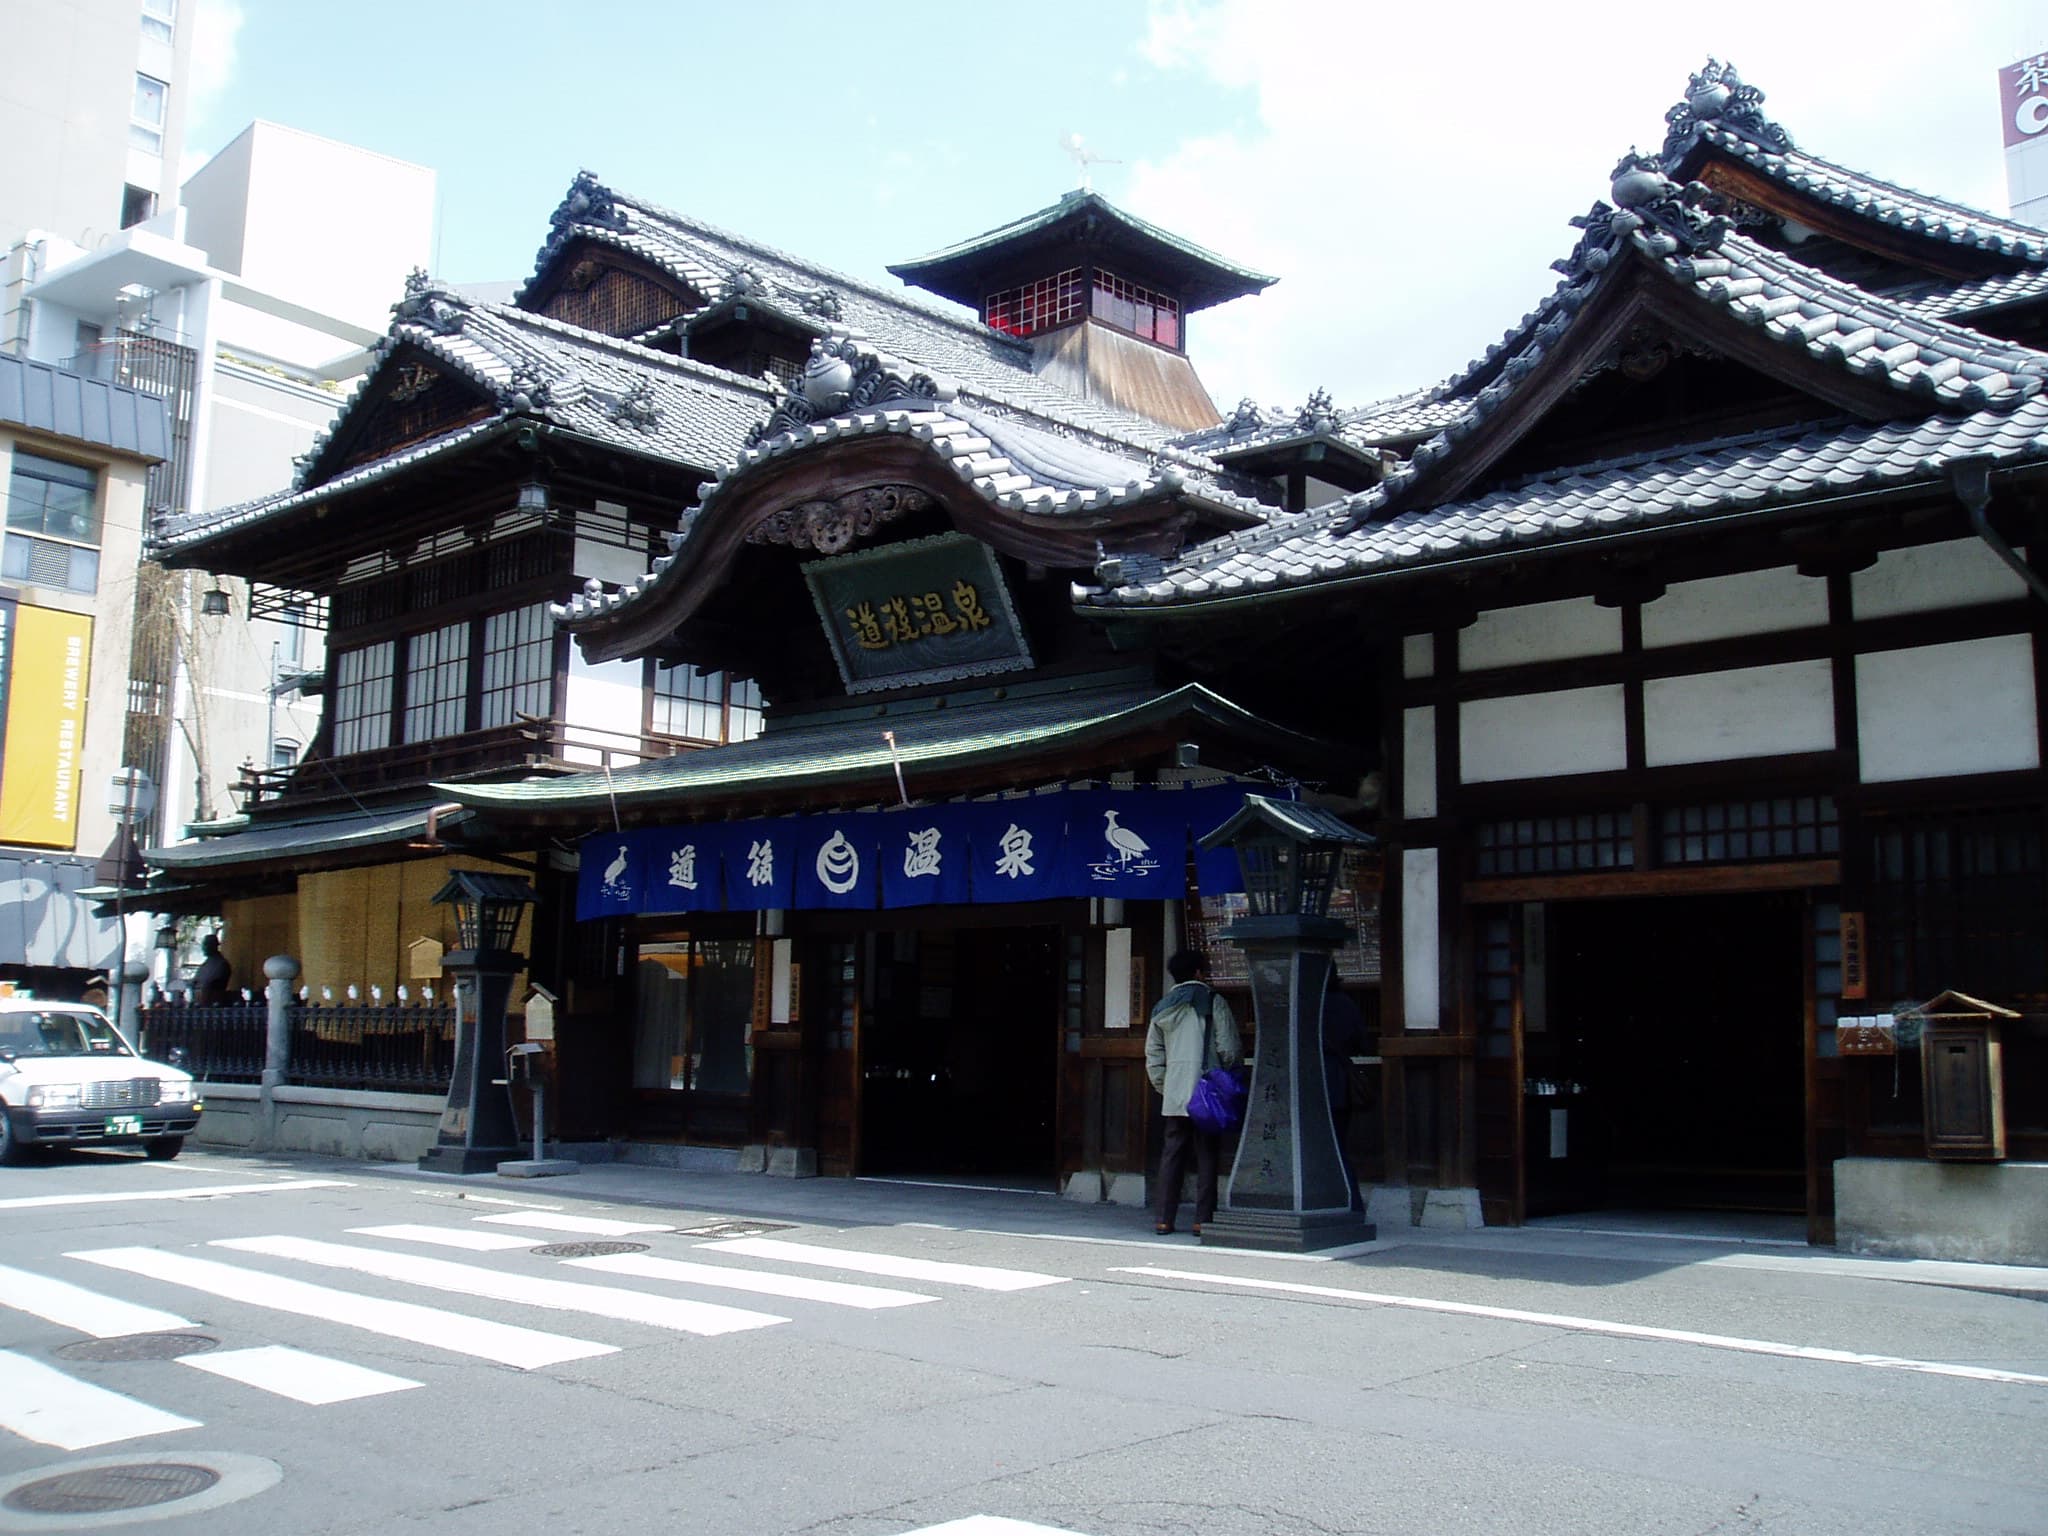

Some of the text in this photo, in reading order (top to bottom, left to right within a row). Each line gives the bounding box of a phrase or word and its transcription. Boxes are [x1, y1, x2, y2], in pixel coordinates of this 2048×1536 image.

[846, 580, 991, 649] 道後温泉
[53, 636, 82, 822] BREWERY RESTAURANT
